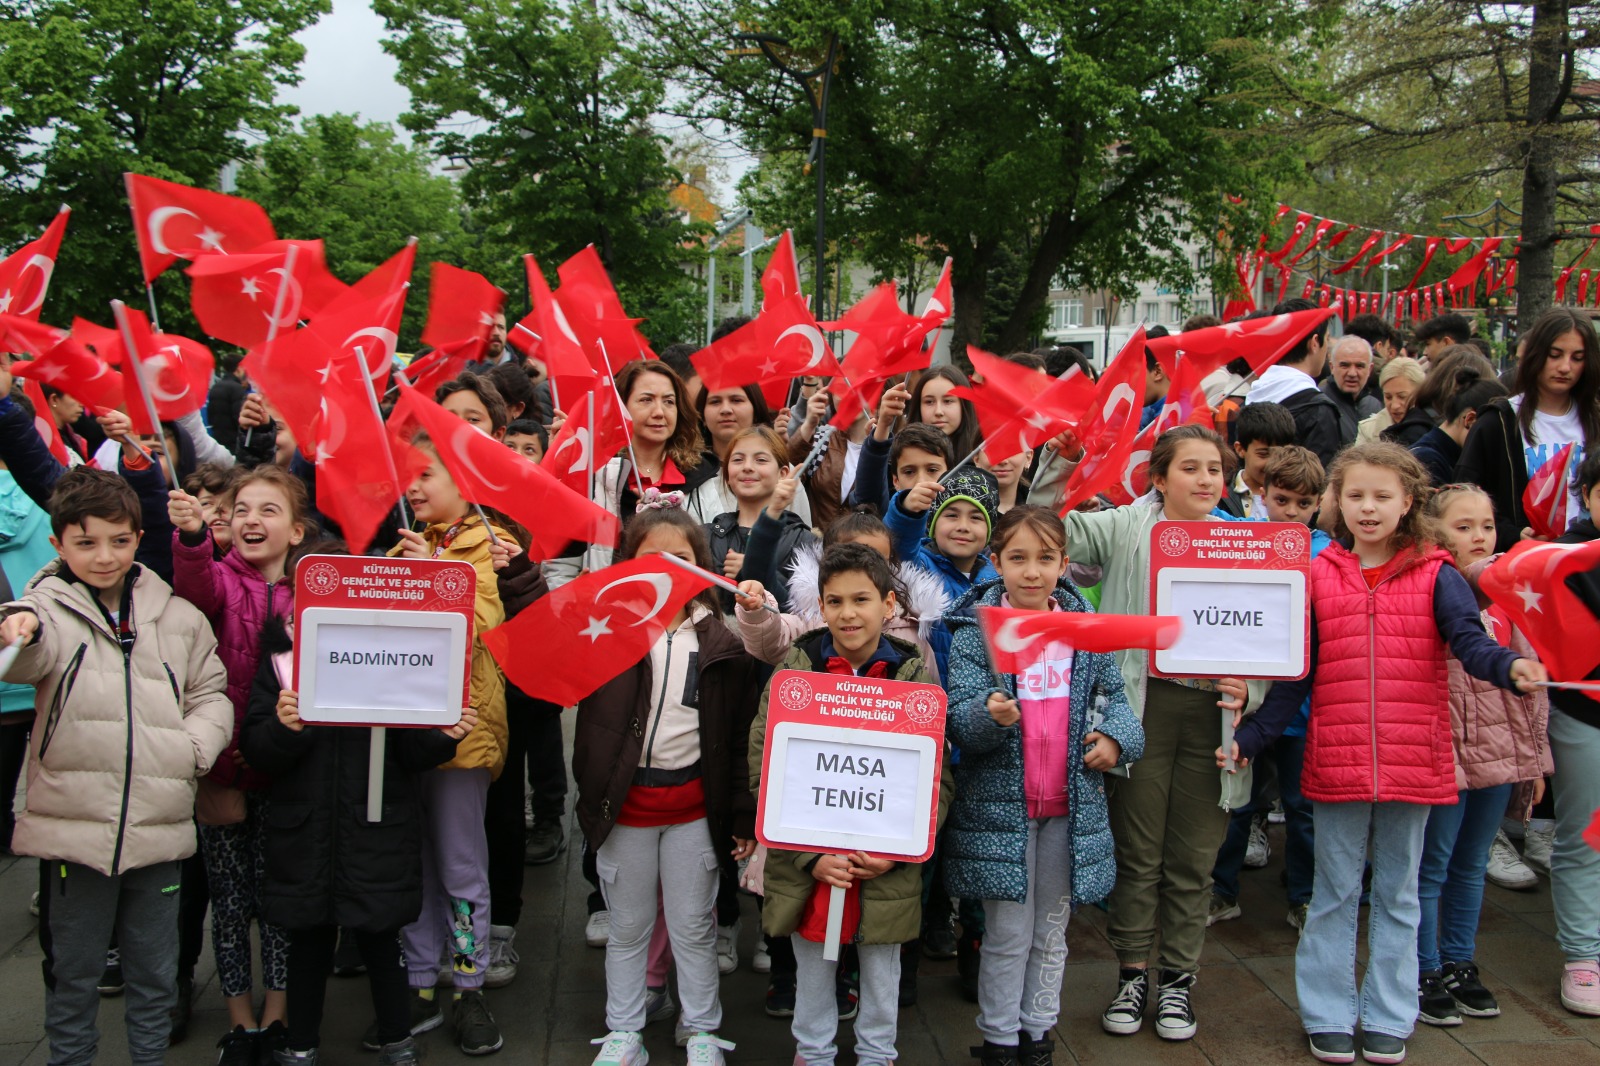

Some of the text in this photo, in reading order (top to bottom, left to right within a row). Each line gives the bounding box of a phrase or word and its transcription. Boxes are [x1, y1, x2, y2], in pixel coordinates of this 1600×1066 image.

[1210, 527, 1254, 537] KÜTAHYA
[1192, 538, 1272, 549] GENÇLİK VE SPOR
[1197, 550, 1266, 560] İL MÜDÜRLÜĞÜ
[363, 564, 412, 576] KÜTAHYA
[342, 576, 432, 589] GENÇLİK VE SPOR
[347, 587, 425, 600] İL MÜDÜRLÜĞÜ
[1193, 606, 1264, 627] YÜZME
[329, 650, 434, 667] BADMİNTON
[836, 681, 883, 696] KÜTAHYA
[814, 692, 903, 710] GENÇLİK VE SPOR
[819, 706, 896, 722] İL MÜDÜRLÜĞÜ
[816, 752, 886, 778] MASA
[811, 786, 885, 813] TENİSİ
